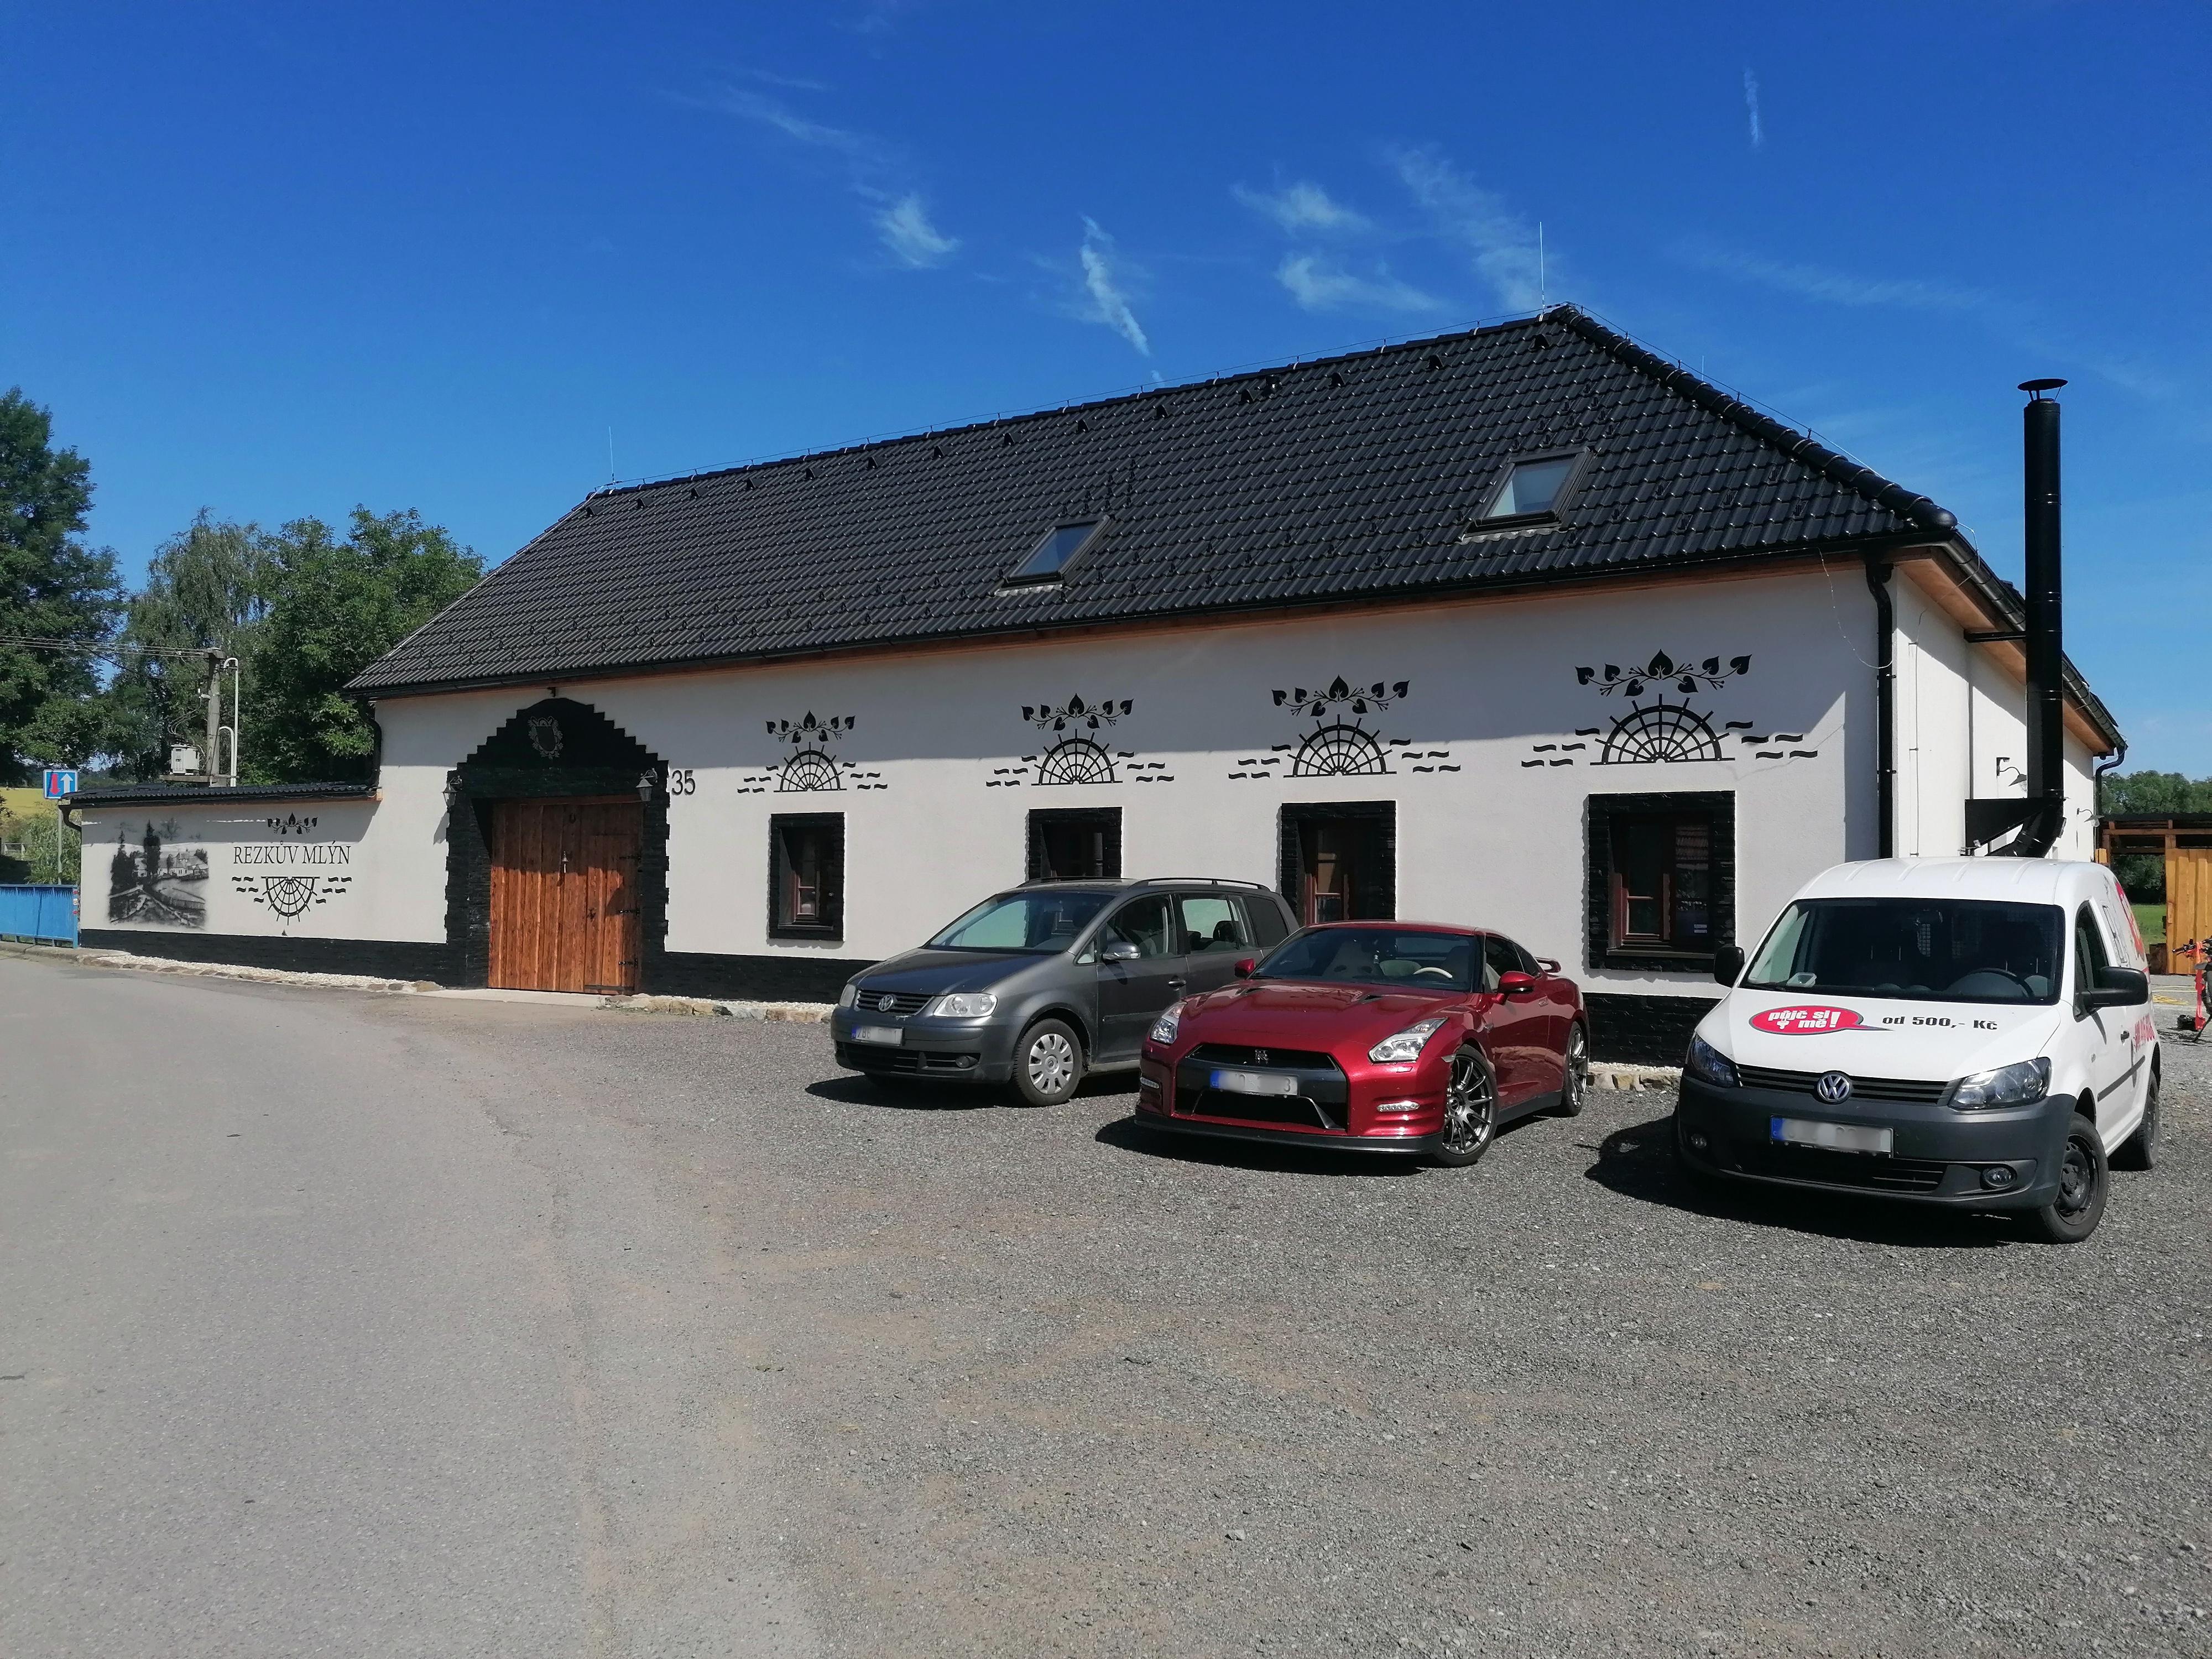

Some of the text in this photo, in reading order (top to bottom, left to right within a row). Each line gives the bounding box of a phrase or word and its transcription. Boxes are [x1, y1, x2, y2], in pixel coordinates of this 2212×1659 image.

[671, 770, 695, 795] 35
[233, 840, 351, 864] REZKŮV MLÝN
[1812, 1010, 1830, 1019] si
[1912, 1016, 1966, 1029] 500,-
[1973, 1019, 1998, 1030] Kč
